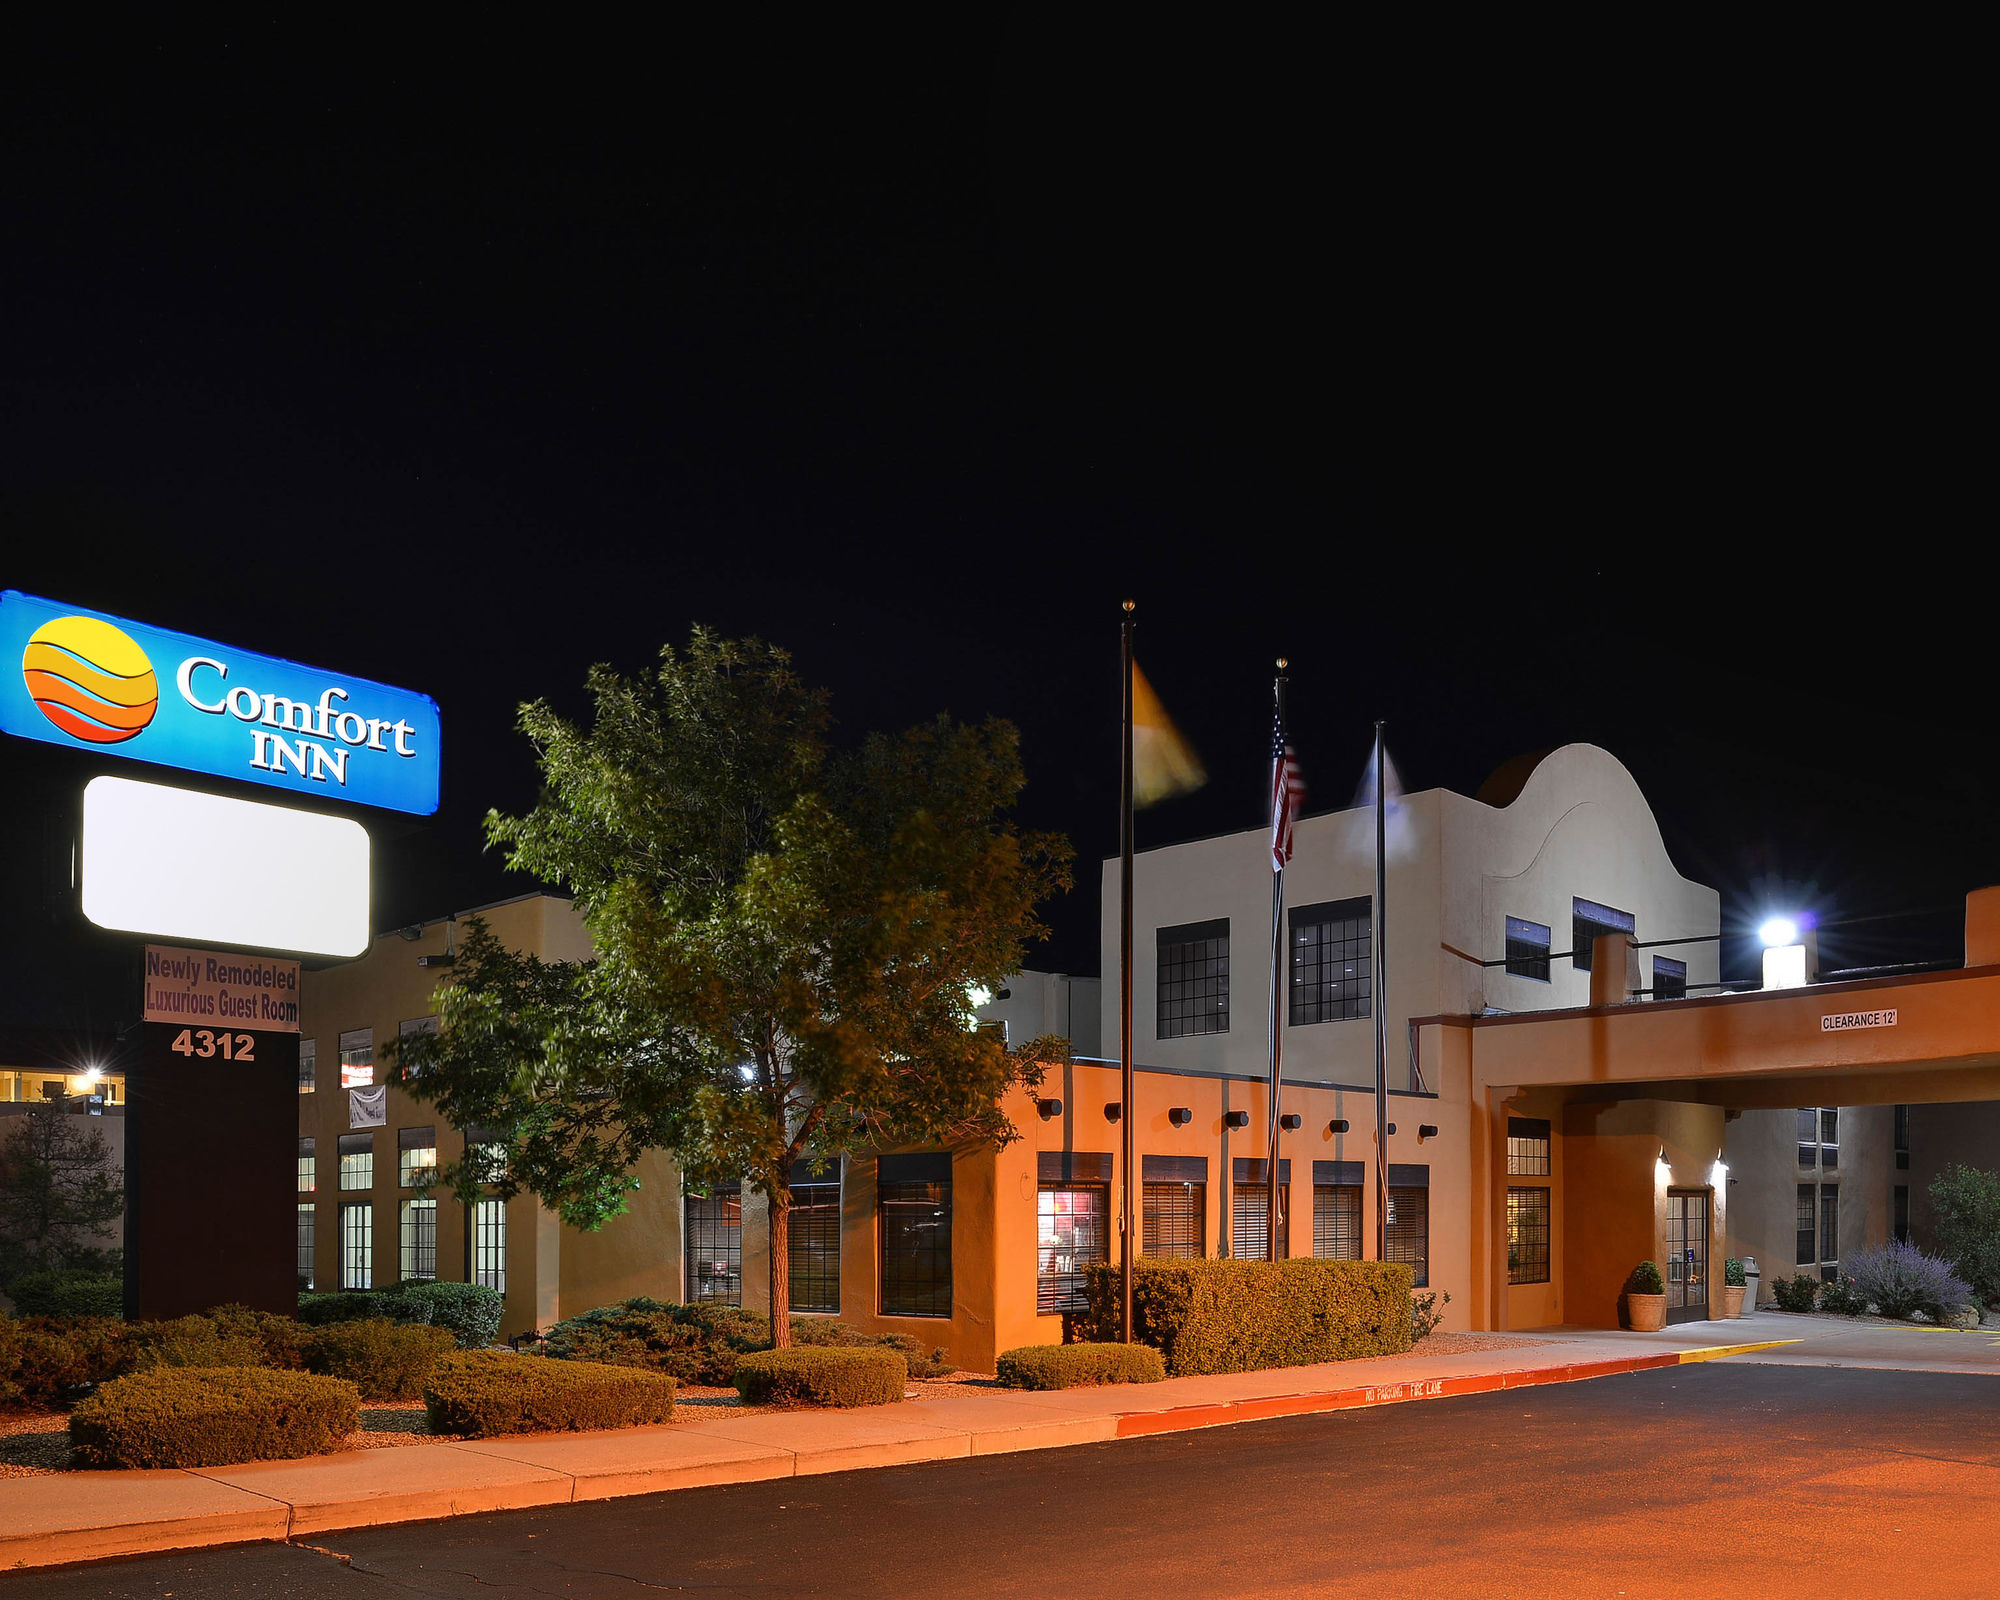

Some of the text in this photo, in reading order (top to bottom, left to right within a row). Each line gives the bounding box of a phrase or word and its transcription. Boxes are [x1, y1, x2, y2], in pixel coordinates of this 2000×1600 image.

[176, 656, 416, 757] Comfort
[249, 729, 350, 787] INN
[147, 951, 296, 991] Newly Remodeled
[146, 983, 297, 1023] Luxurious Guest Room
[1823, 1012, 1880, 1029] CLEARANCE
[171, 1029, 255, 1062] 4312
[1377, 1385, 1403, 1400] PARKING
[1410, 1383, 1424, 1397] FIRE
[1426, 1381, 1443, 1395] LANE
